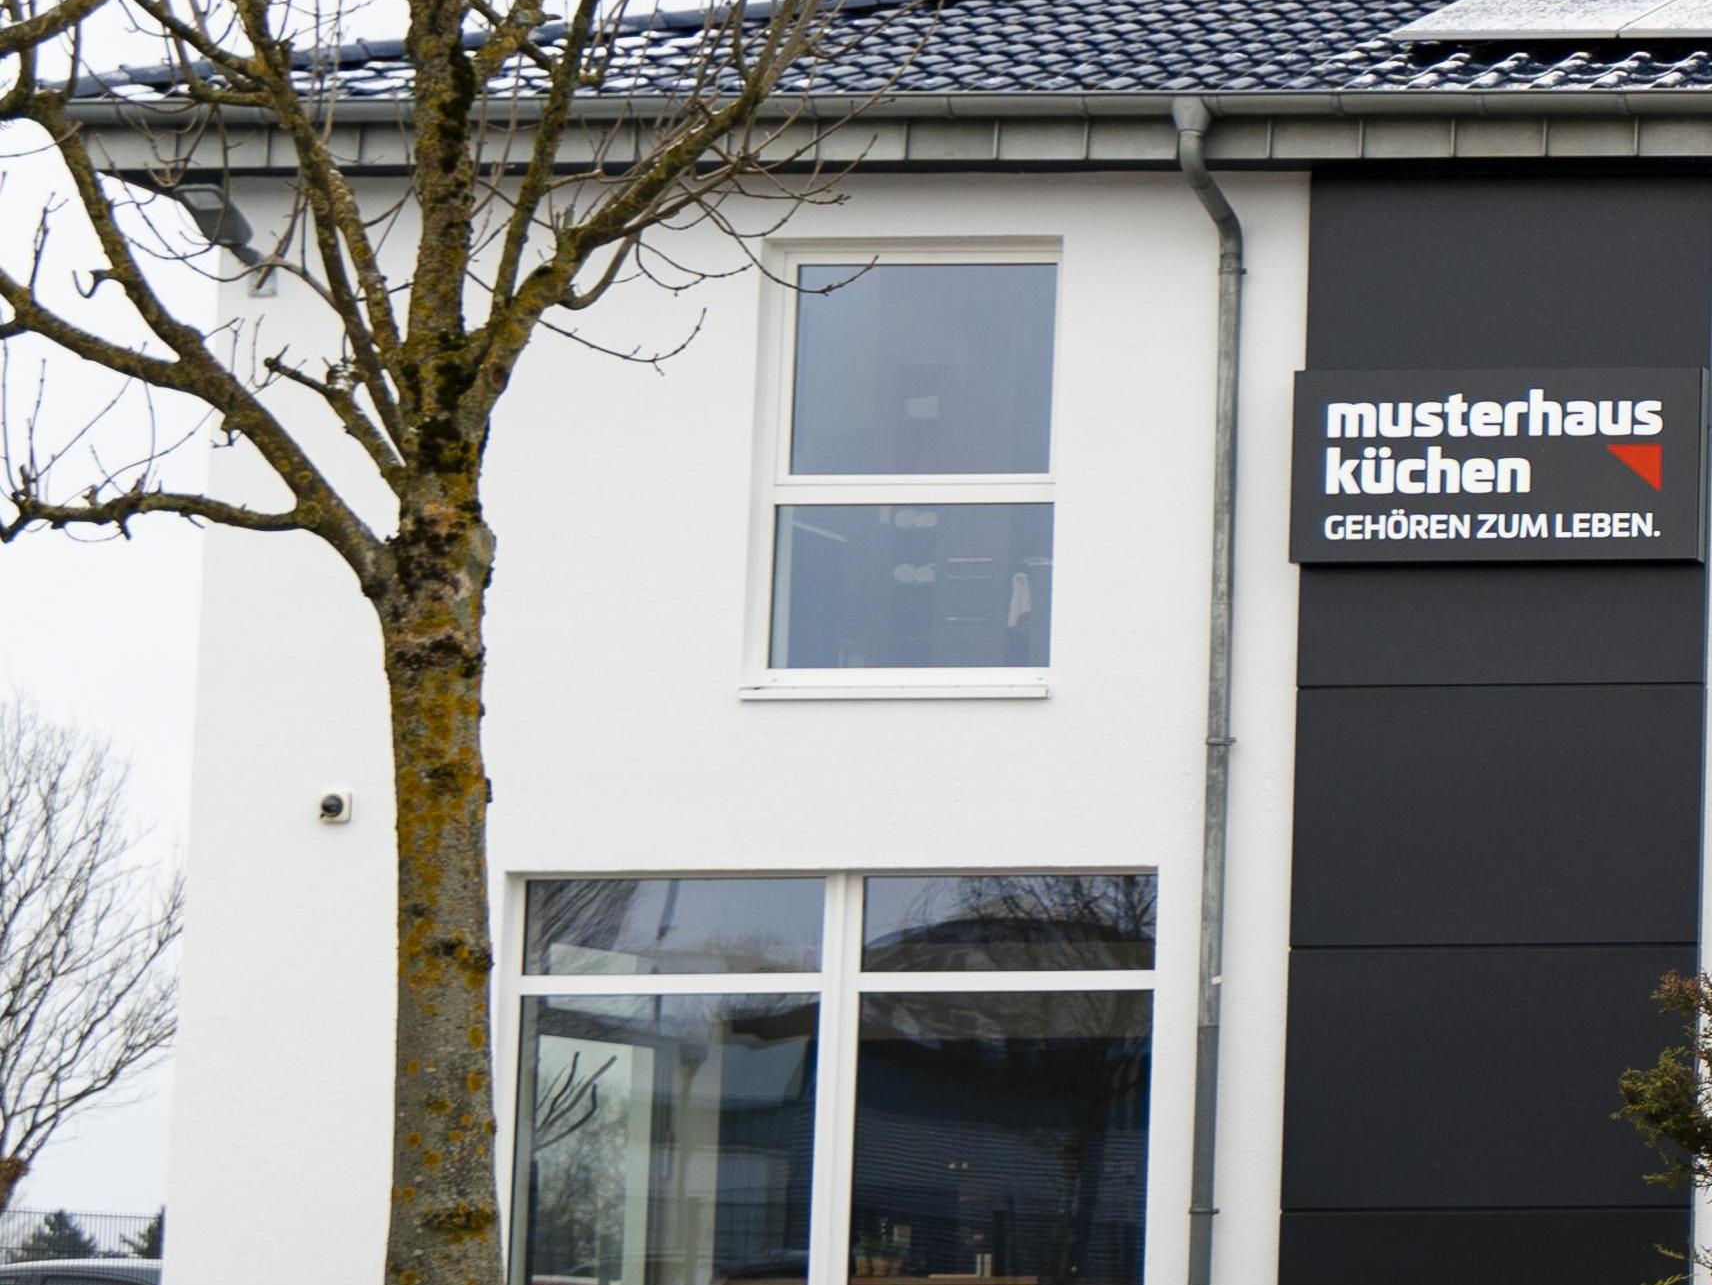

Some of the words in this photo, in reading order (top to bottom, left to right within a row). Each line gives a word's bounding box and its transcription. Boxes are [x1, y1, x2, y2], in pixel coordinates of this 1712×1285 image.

[1326, 388, 1663, 438] musterhaus
[1325, 446, 1531, 495] küchen
[1324, 509, 1471, 540] GEHÖREN
[1476, 513, 1548, 539] ZUM
[1555, 512, 1661, 539] LEBEN.
